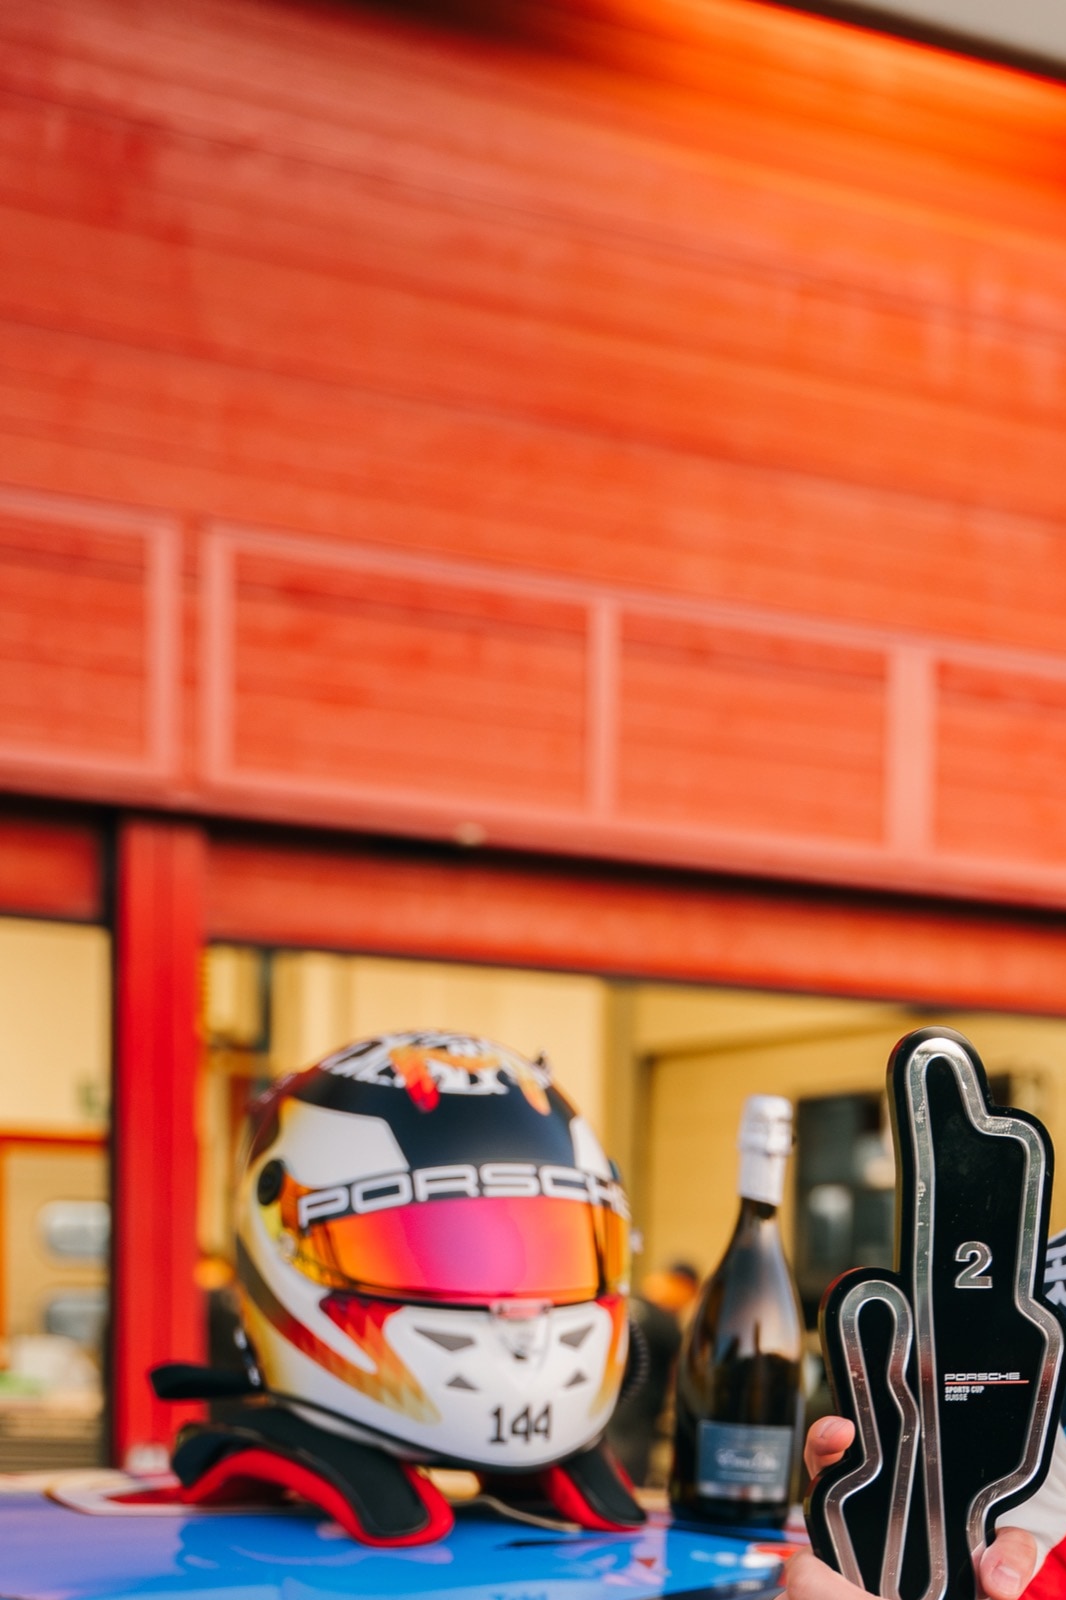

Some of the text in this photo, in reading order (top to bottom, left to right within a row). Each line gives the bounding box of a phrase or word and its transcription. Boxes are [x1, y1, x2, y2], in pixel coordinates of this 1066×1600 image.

[954, 1241, 993, 1289] 2
[944, 1372, 1020, 1381] PORSCHE
[945, 1385, 984, 1394] SPORTS CUP
[487, 1404, 551, 1446] 144
